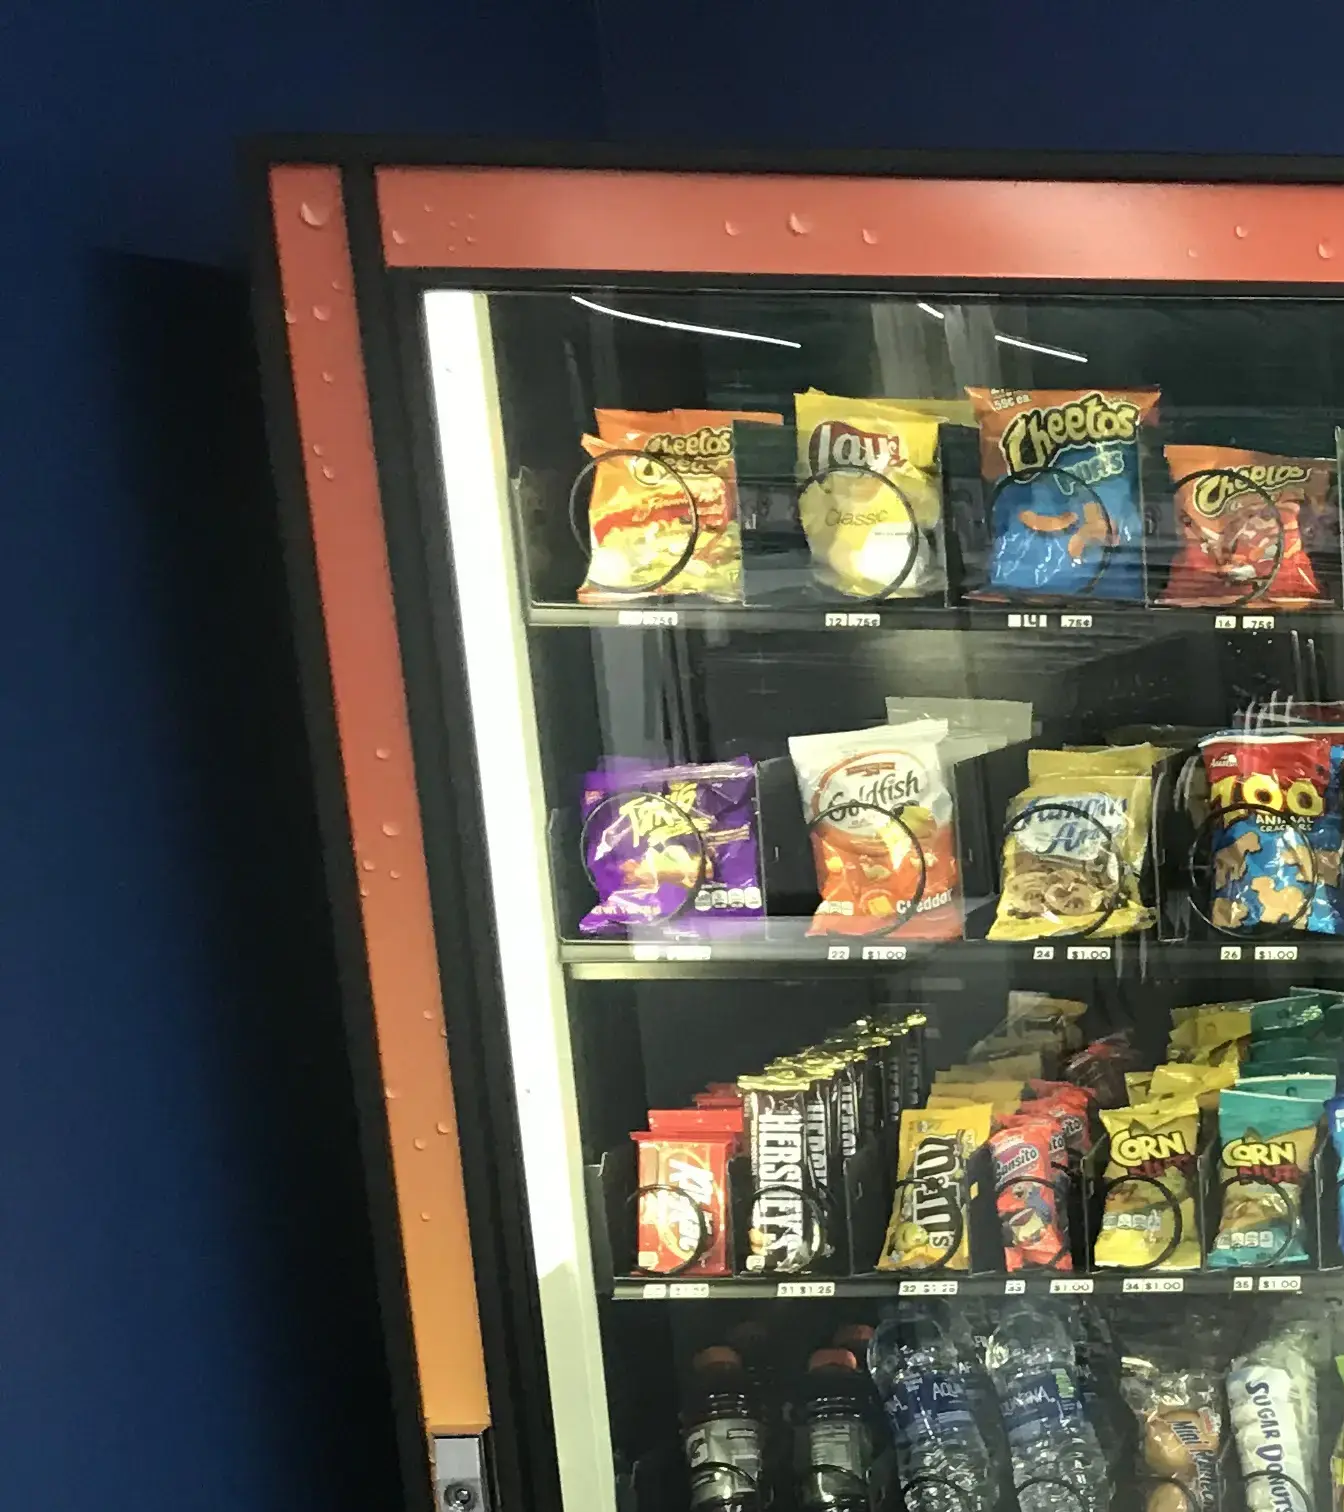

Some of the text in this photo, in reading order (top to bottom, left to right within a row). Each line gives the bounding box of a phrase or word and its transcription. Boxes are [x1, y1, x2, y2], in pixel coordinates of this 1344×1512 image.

[1008, 396, 1136, 472] Cheetos
[831, 951, 846, 960] 22
[1036, 949, 1109, 961] 24 $1.00
[1223, 950, 1296, 961] 26 $1.00
[1109, 1129, 1187, 1168] CORN
[1221, 1138, 1296, 1168] CORN
[780, 1285, 832, 1295] 31 $1.25
[902, 1284, 917, 1293] 32
[1125, 1280, 1182, 1291] 34 $1.00
[1235, 1280, 1250, 1290] 35
[1245, 1381, 1282, 1439] SUGAR
